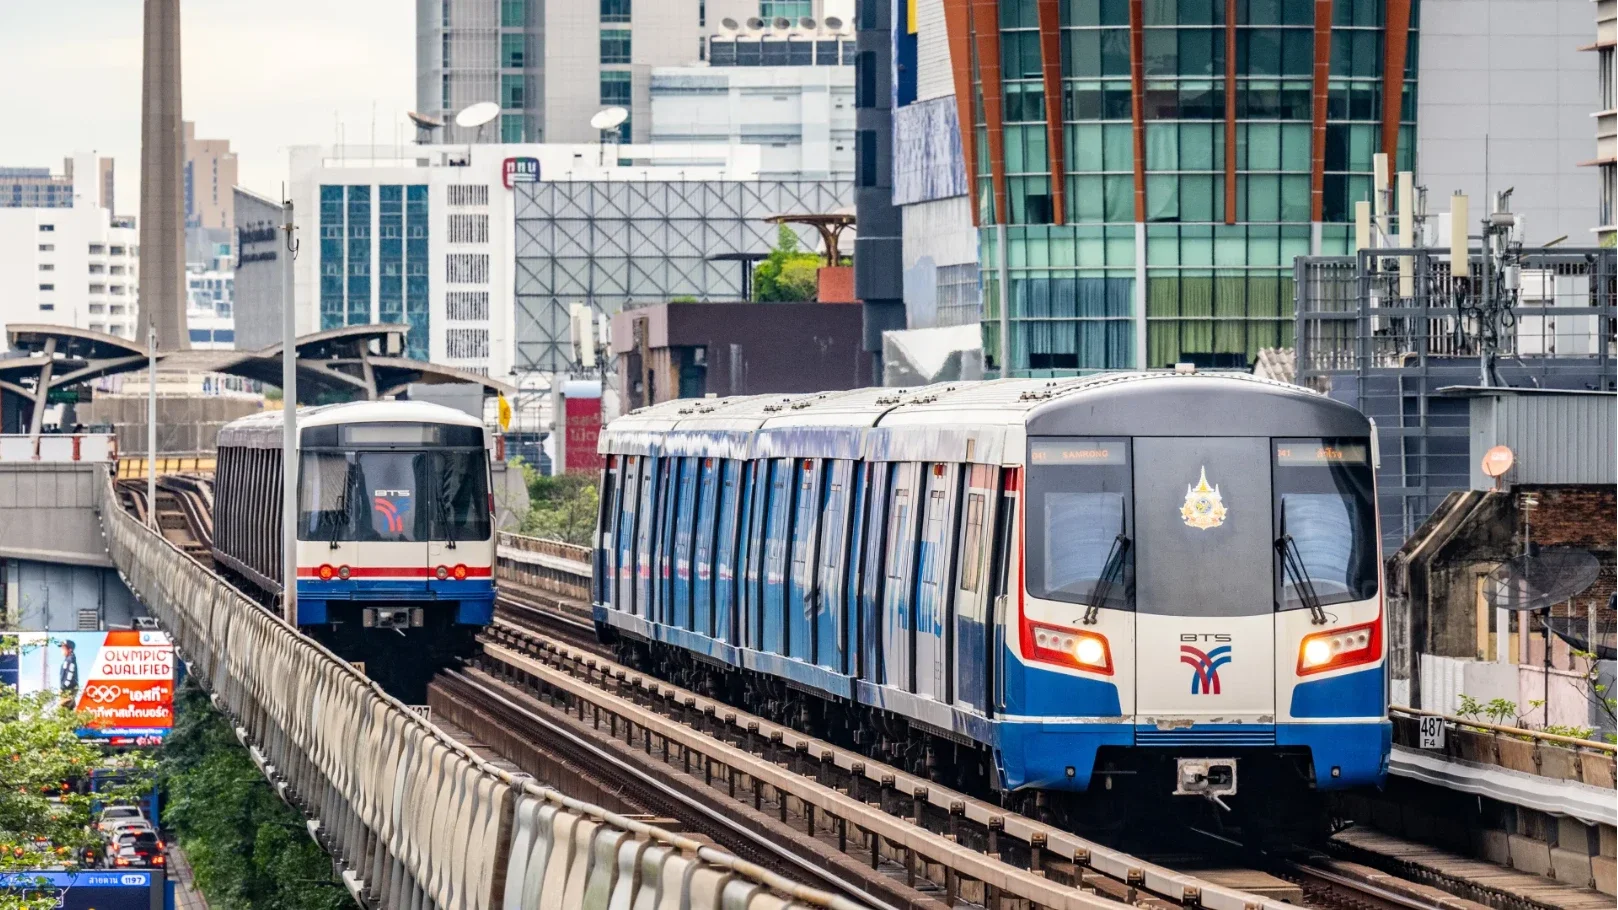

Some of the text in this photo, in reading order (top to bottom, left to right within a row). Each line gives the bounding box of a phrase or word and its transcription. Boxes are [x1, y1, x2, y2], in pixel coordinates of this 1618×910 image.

[1062, 450, 1109, 459] SAMRONG
[374, 489, 410, 497] BTS
[1180, 633, 1232, 642] BTS
[105, 650, 167, 662] OLYMPIC
[102, 663, 170, 675] QUALIFIED
[1421, 717, 1443, 737] 487
[1424, 738, 1436, 747] F4
[125, 876, 142, 884] 1197
